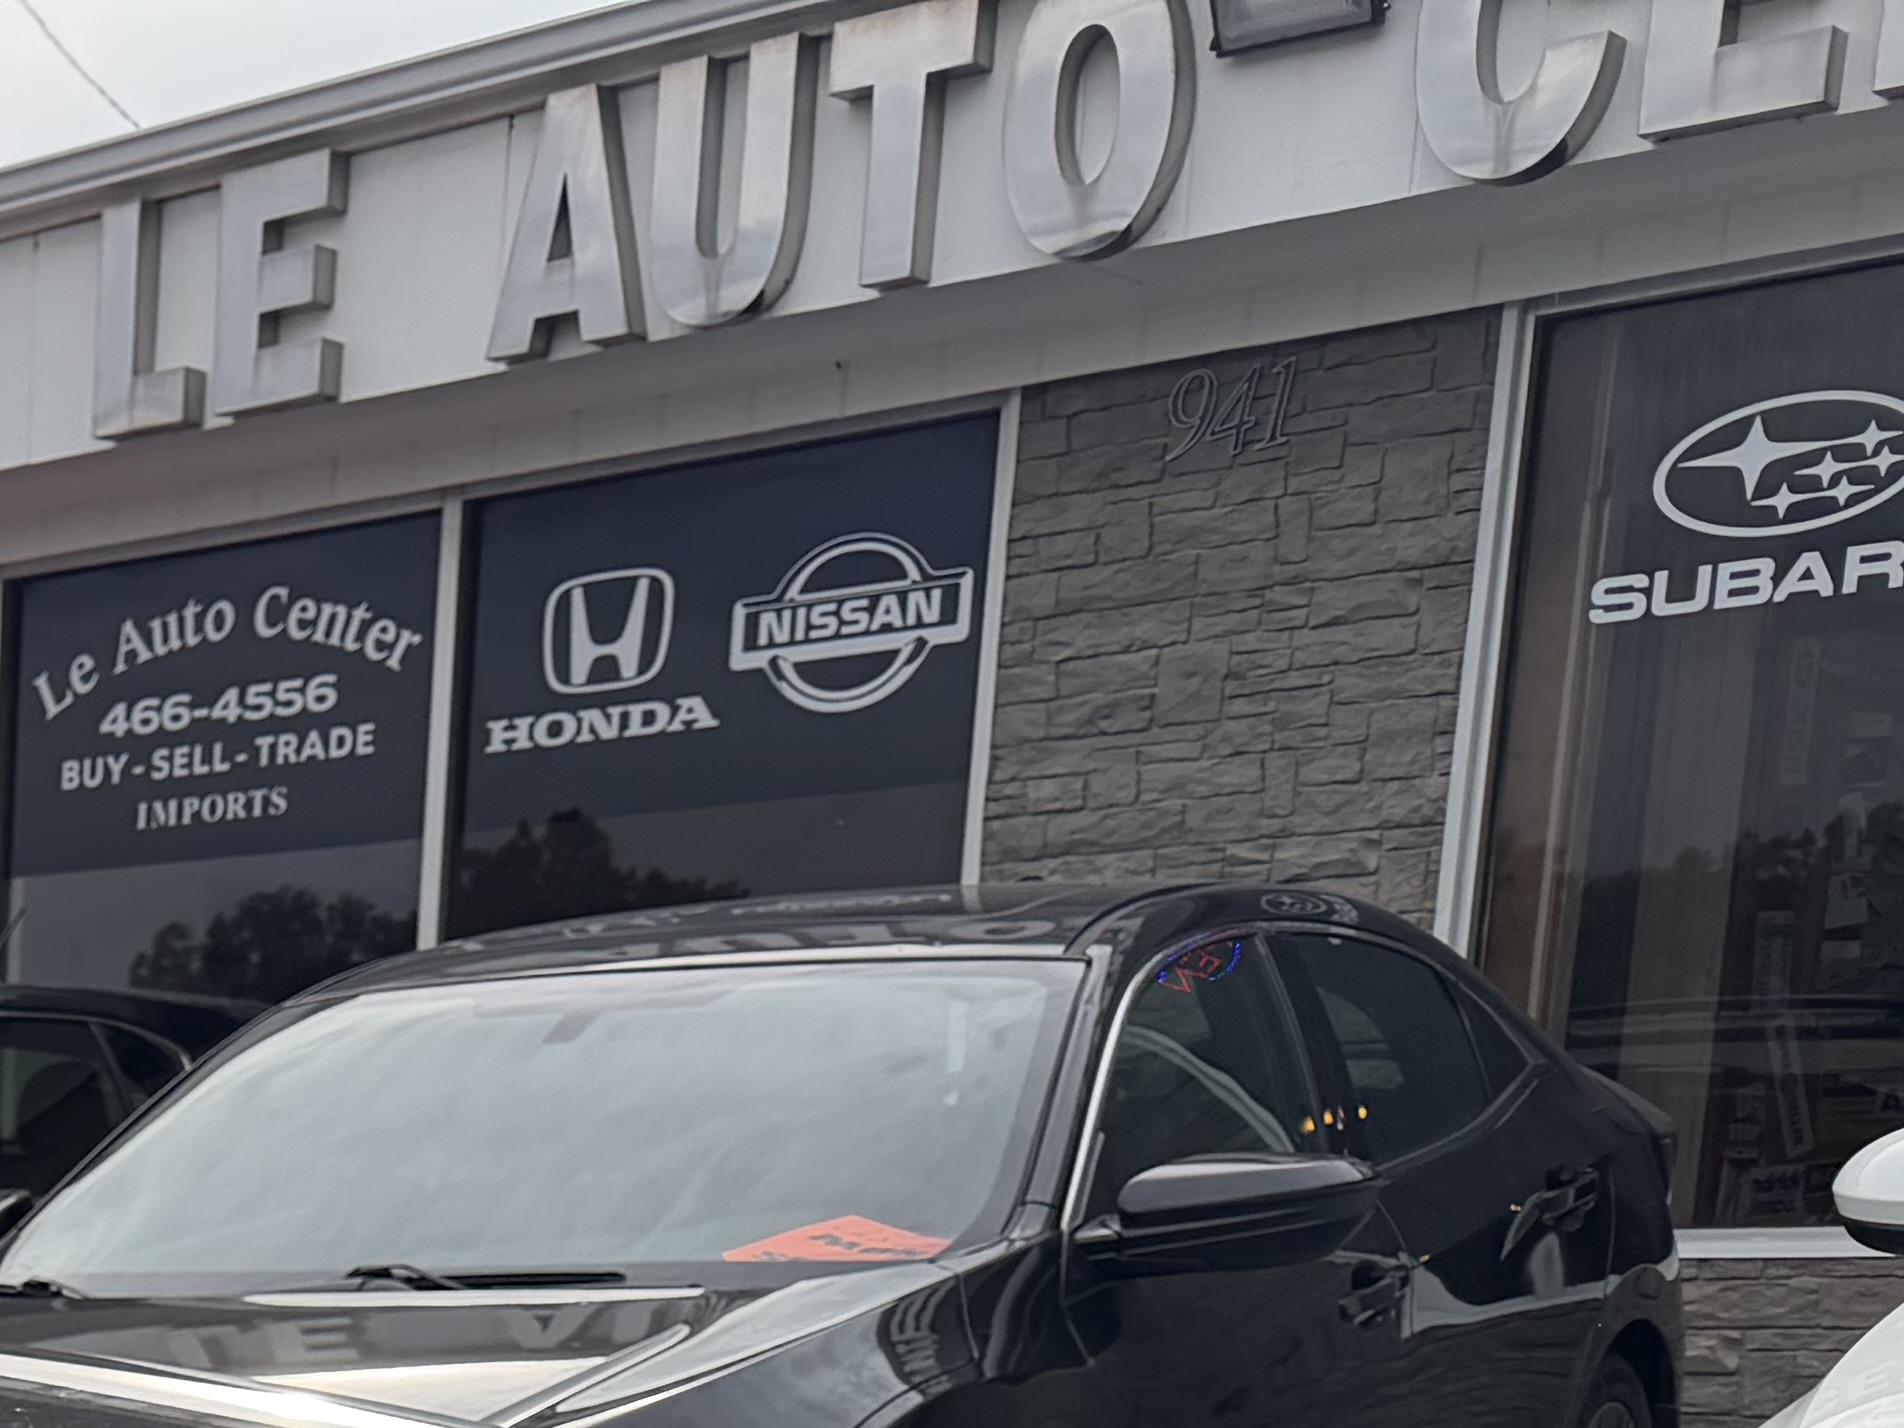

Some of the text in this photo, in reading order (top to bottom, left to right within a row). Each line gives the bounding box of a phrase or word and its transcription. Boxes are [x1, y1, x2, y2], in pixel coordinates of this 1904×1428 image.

[95, 148, 349, 439] LE
[486, 0, 1196, 363] AUTO
[1165, 357, 1297, 462] 941
[756, 588, 942, 647] NISSAN
[32, 585, 423, 721] Le Auto Center
[98, 673, 339, 738] 466-4556
[484, 696, 720, 754] HONDA
[135, 785, 288, 831] IMPORTS
